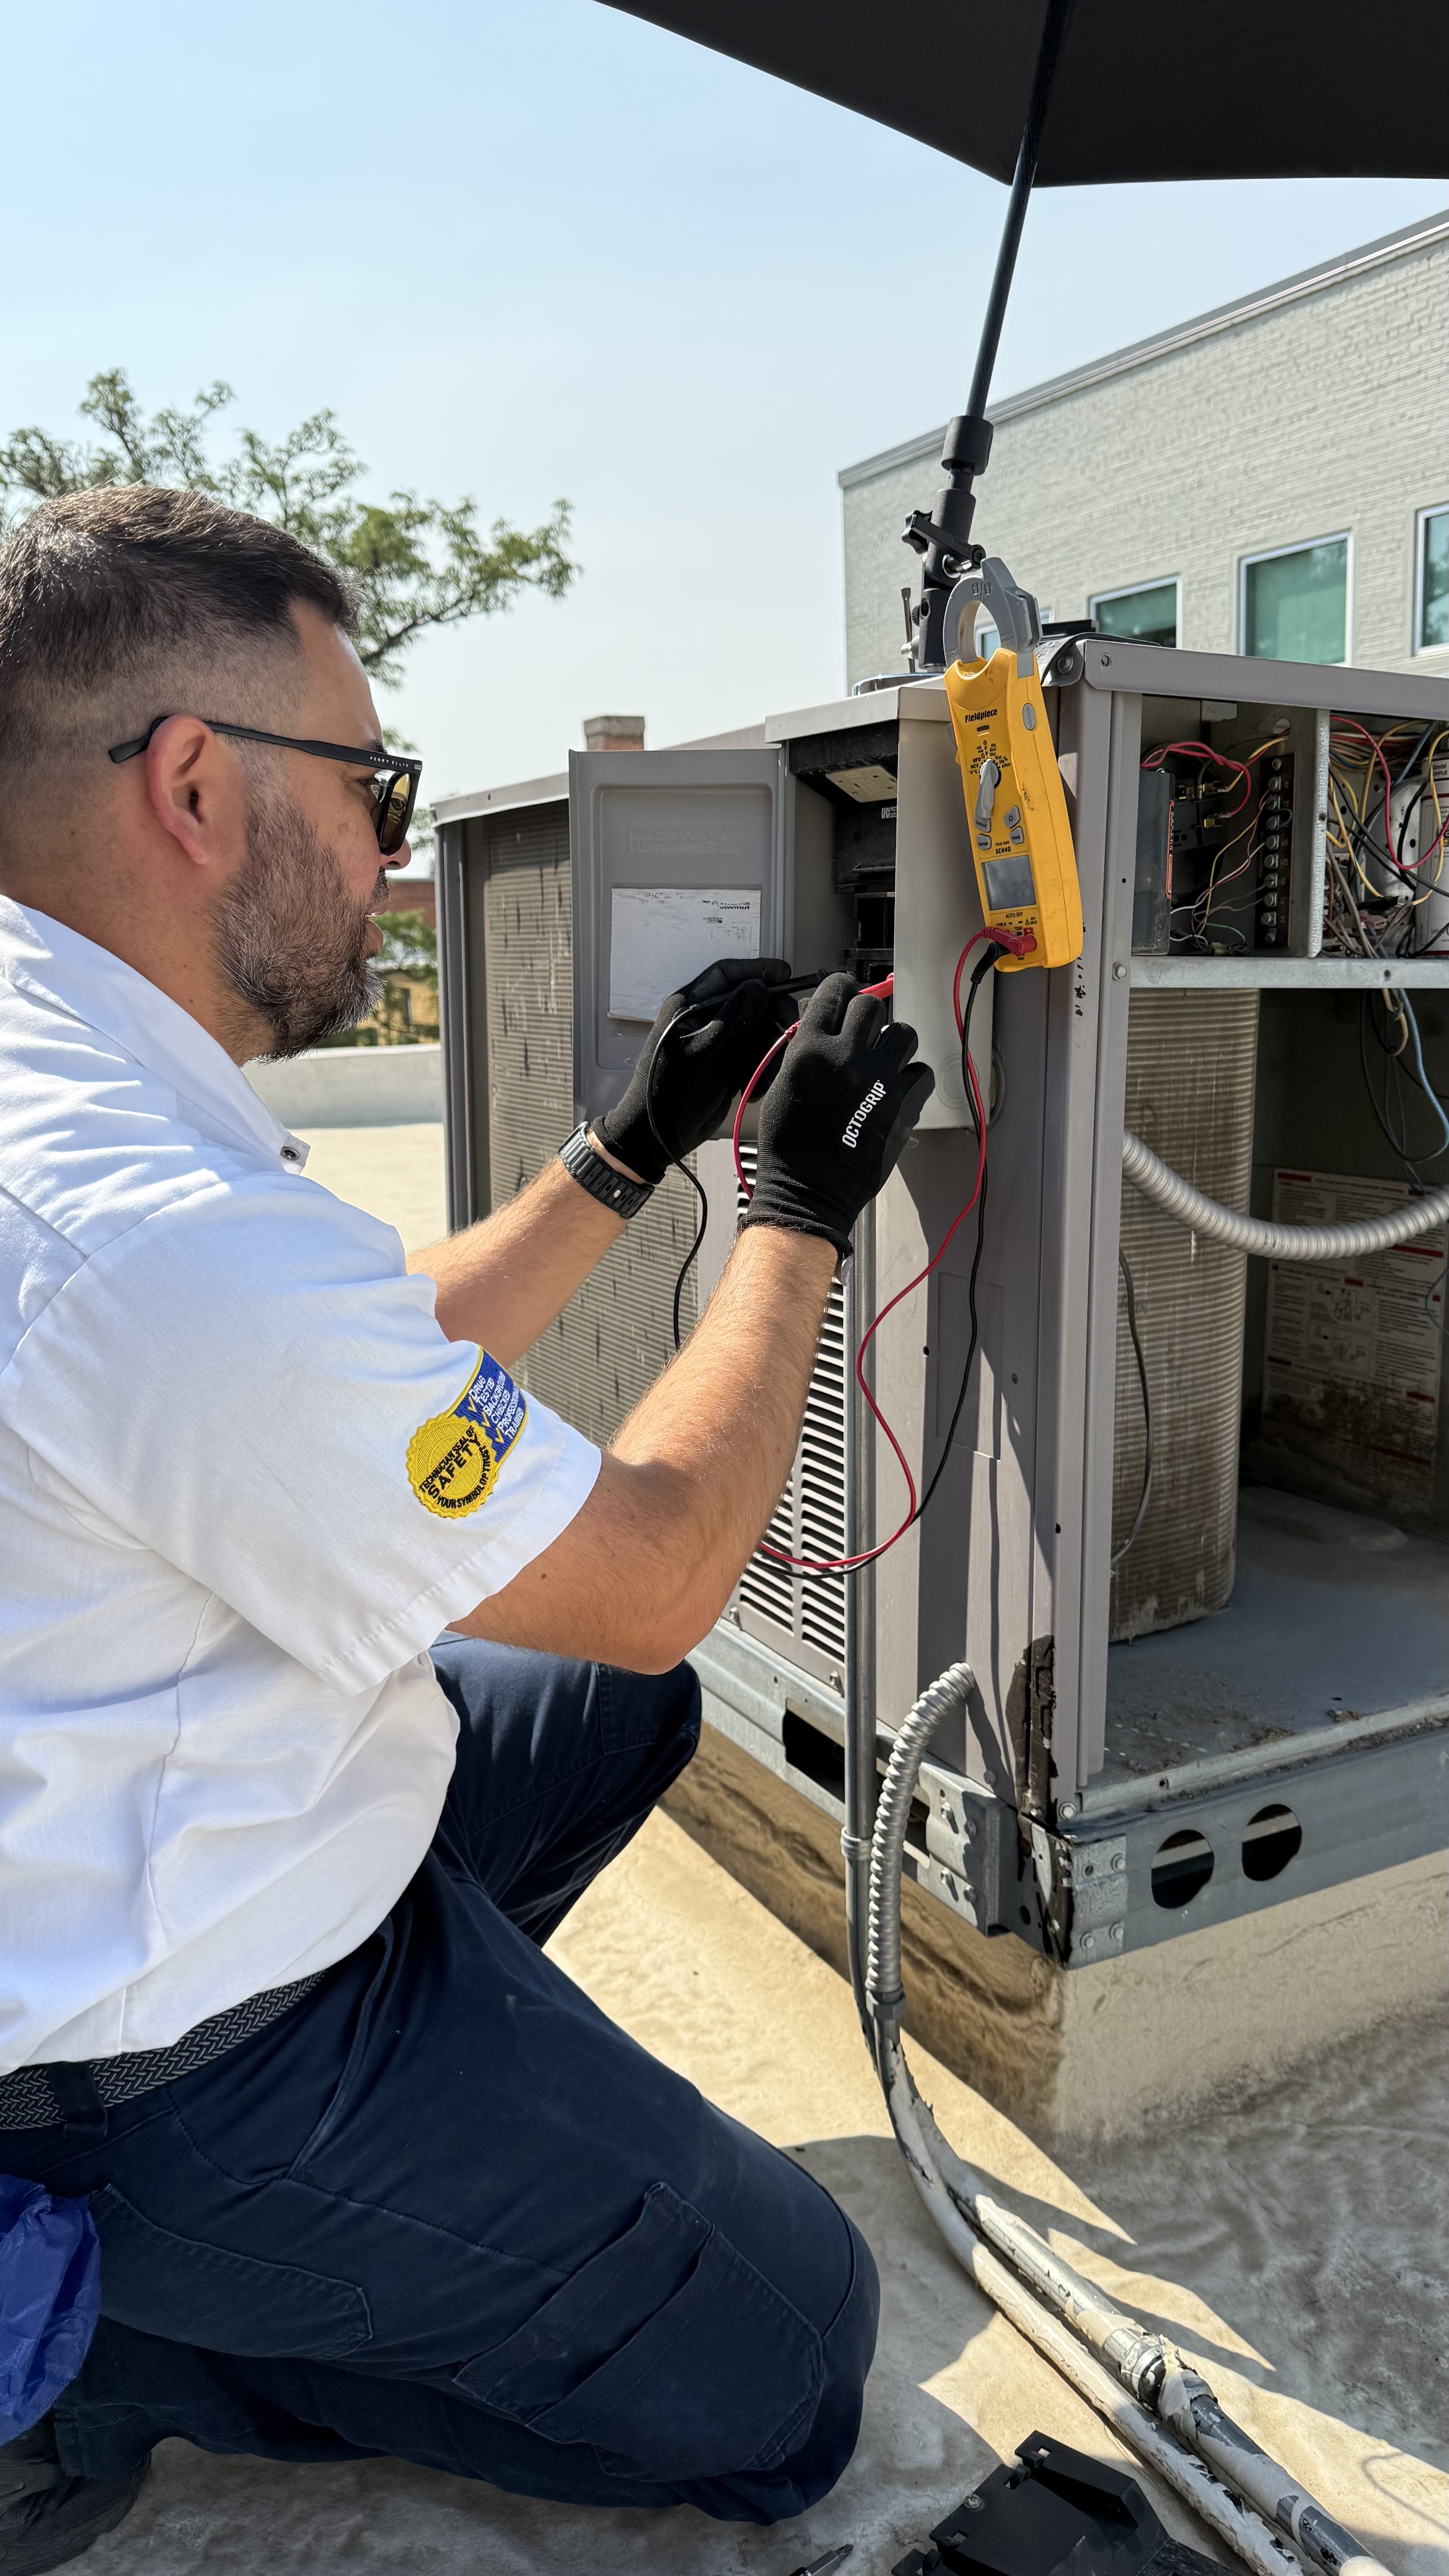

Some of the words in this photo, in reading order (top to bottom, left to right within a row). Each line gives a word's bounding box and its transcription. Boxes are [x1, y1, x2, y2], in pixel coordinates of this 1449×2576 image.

[965, 708, 998, 723] Fieldpiece
[995, 846, 1011, 855] SC440
[842, 1080, 887, 1148] OCTOGRIP
[468, 1375, 486, 1401] DRUG
[475, 1377, 495, 1407] TESTED
[482, 1371, 506, 1417] BACKGROUND
[491, 1389, 511, 1424] CHECKED
[504, 1407, 524, 1440] TRAINED
[419, 1449, 455, 1493] TECHNICIAN
[452, 1435, 469, 1454] SEAL
[465, 1425, 474, 1438] OF
[428, 1432, 482, 1499] SAFETY
[478, 1445, 491, 1472] TRUST
[479, 1472, 489, 1486] OF
[437, 1495, 457, 1509] YOUR
[457, 1484, 485, 1508] SYMBOL
